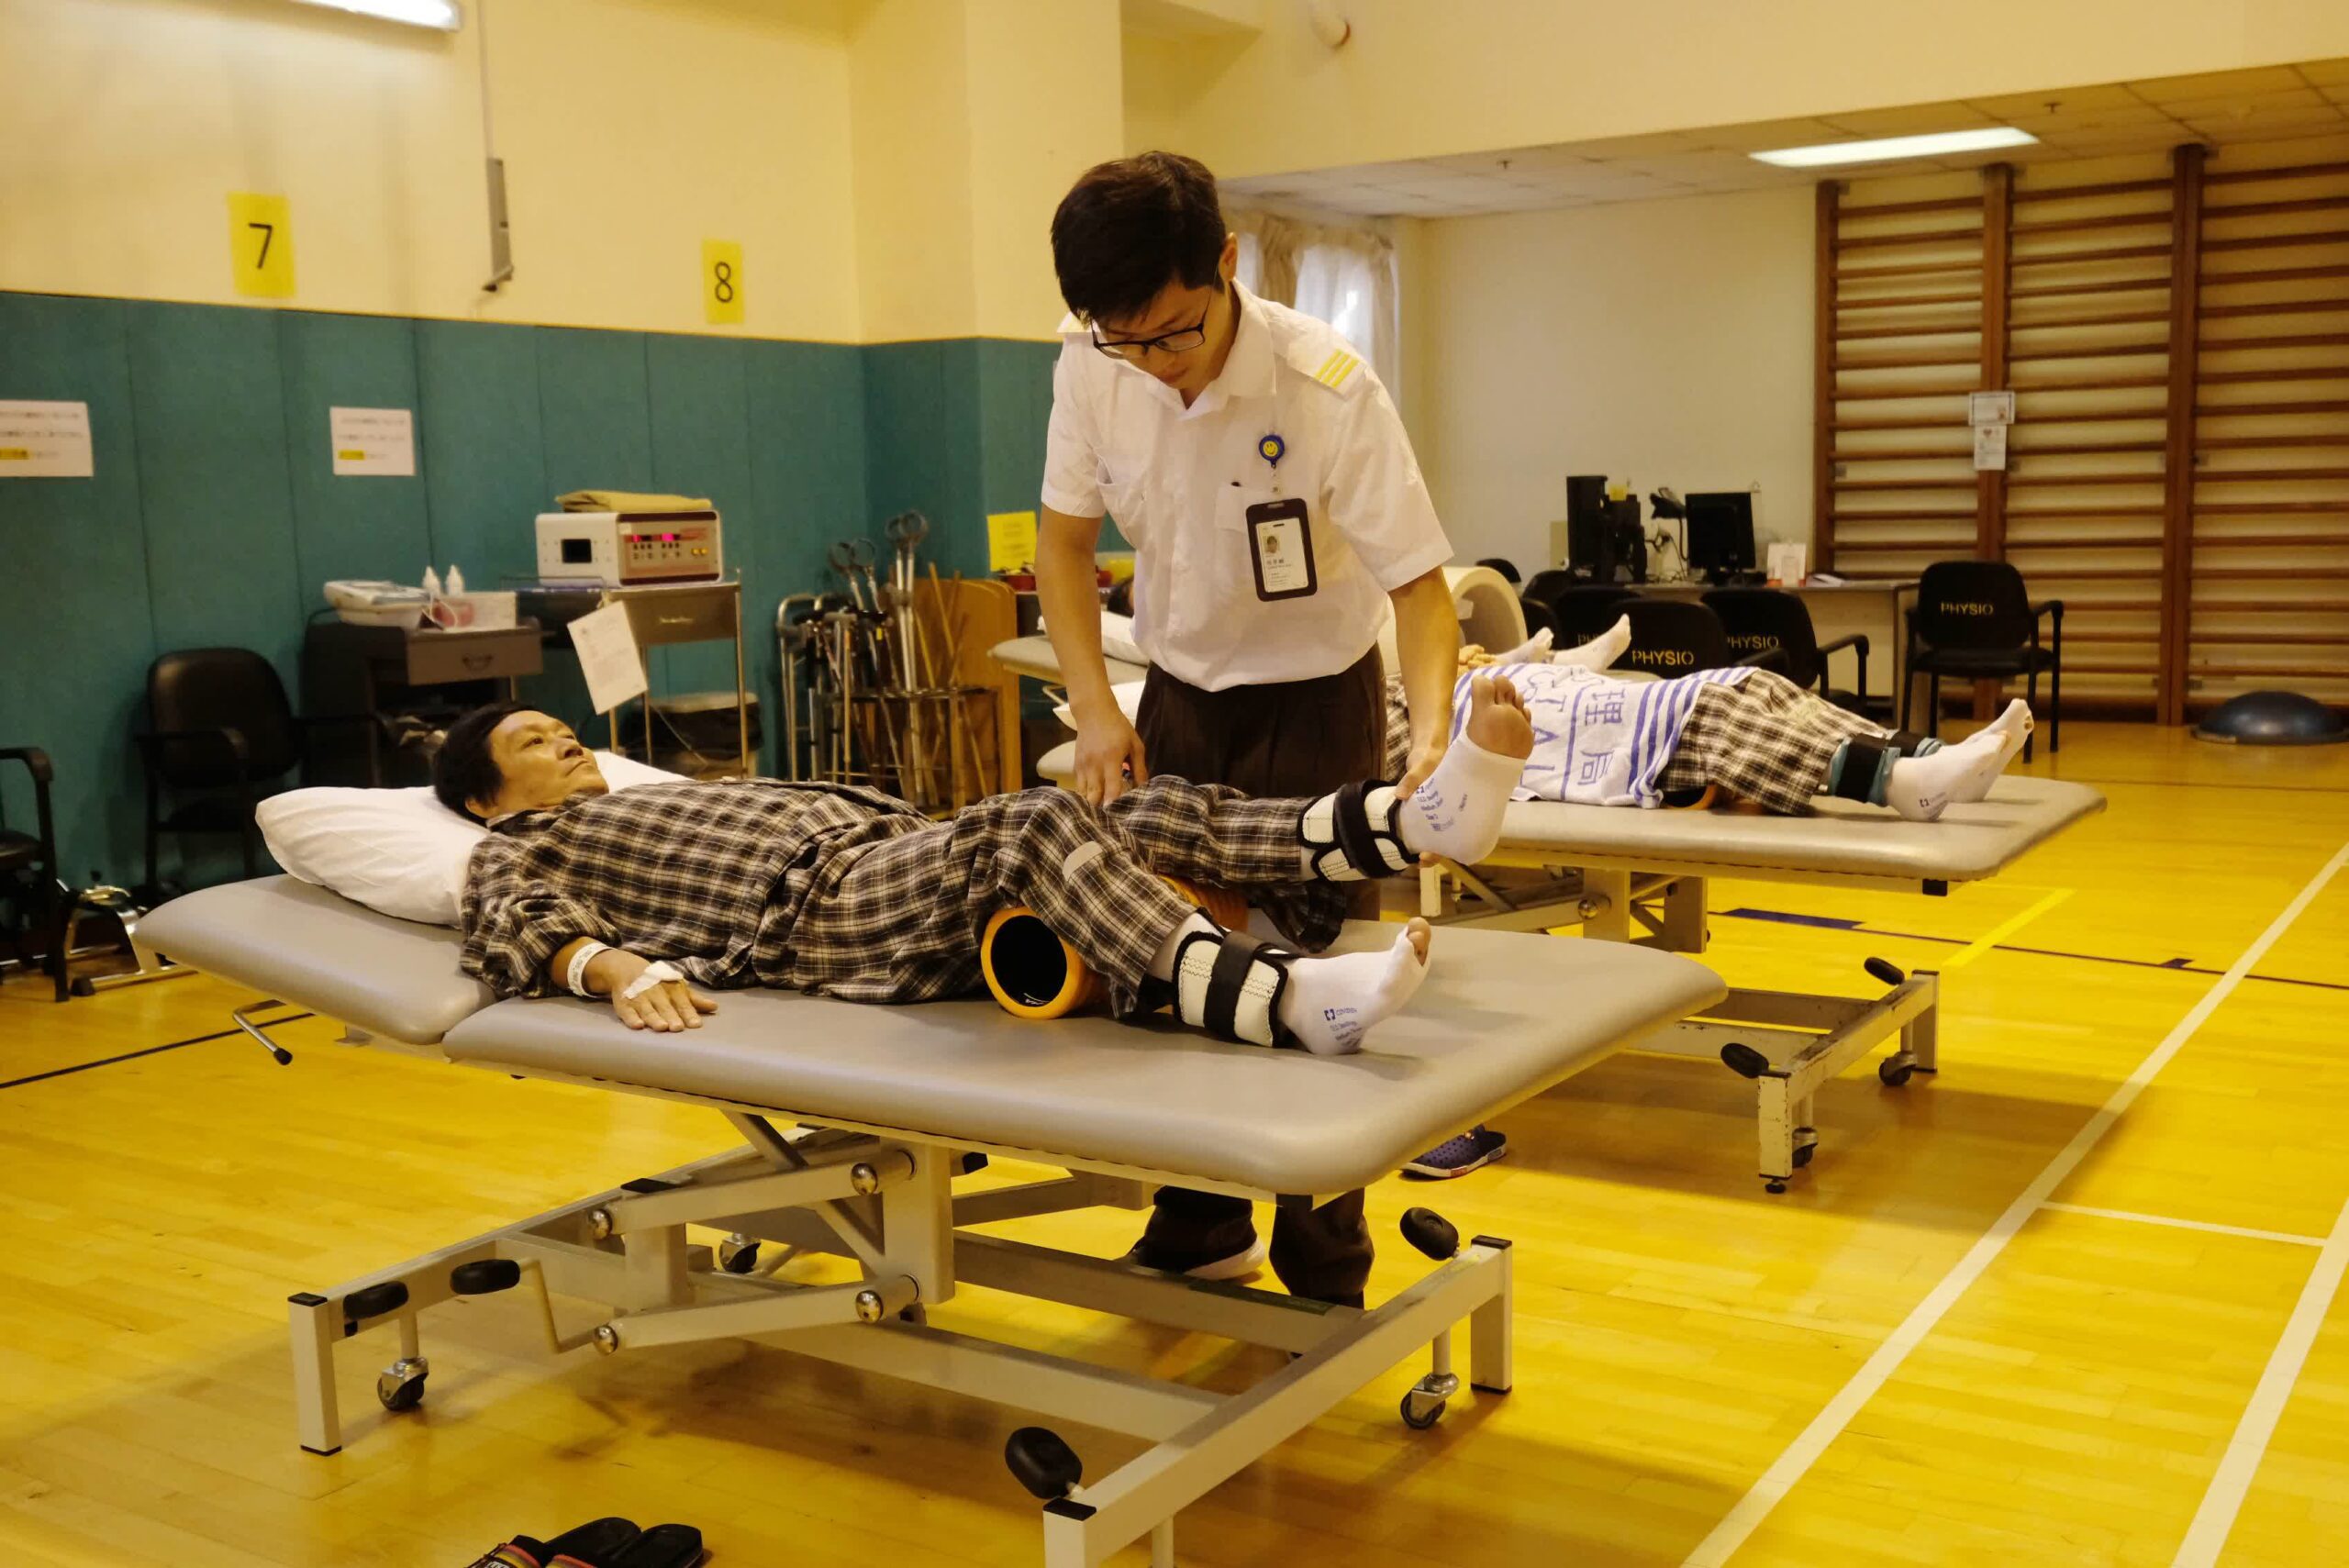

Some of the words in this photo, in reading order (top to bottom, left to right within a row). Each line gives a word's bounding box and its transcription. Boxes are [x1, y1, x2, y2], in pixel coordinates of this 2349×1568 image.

[249, 222, 273, 269] 7
[714, 261, 734, 303] 8
[1940, 601, 1994, 616] PHYSIO
[1631, 650, 1695, 665] PHYSIO
